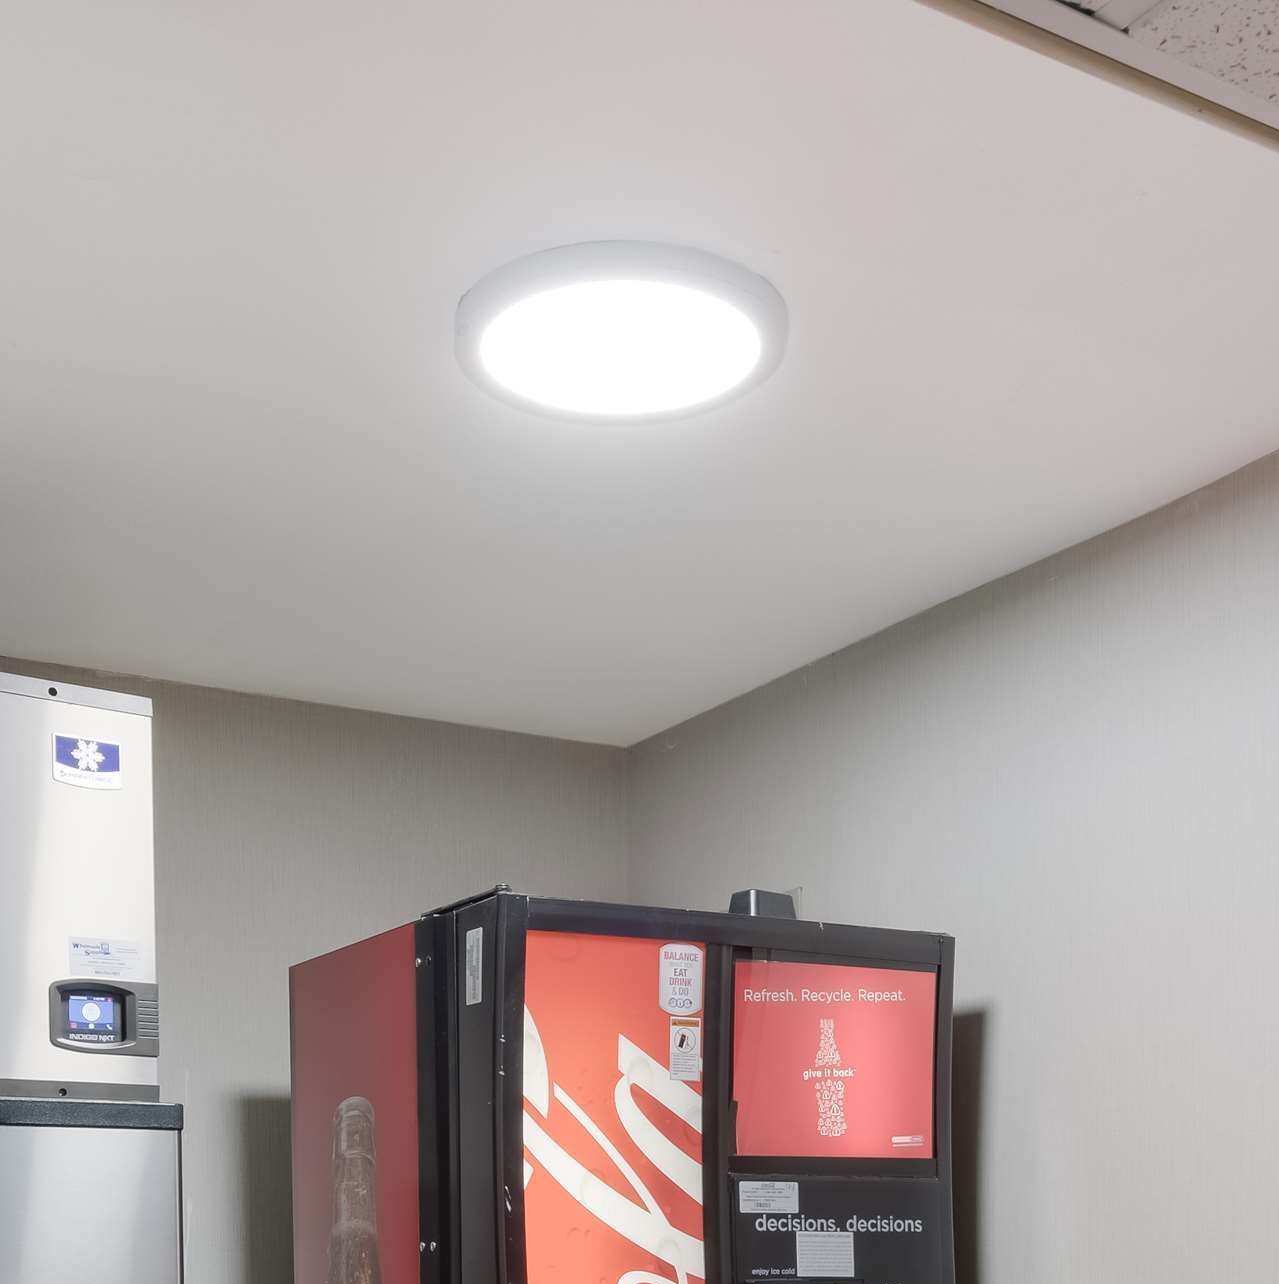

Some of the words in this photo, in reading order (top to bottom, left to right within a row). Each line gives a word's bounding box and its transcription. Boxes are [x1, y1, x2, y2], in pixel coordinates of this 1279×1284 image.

[663, 951, 699, 962] BALANCE
[673, 968, 688, 977] EAT
[669, 977, 692, 986] DRINK
[744, 988, 797, 1002] Refresh.
[801, 988, 854, 1004] Recycle.
[858, 988, 906, 1004] Repeat.
[803, 1069, 821, 1080] give
[825, 1068, 832, 1077] it
[846, 1215, 922, 1232] decisions
[751, 1267, 769, 1276] enjoy
[770, 1267, 780, 1275] ice
[781, 1267, 795, 1275] cold
